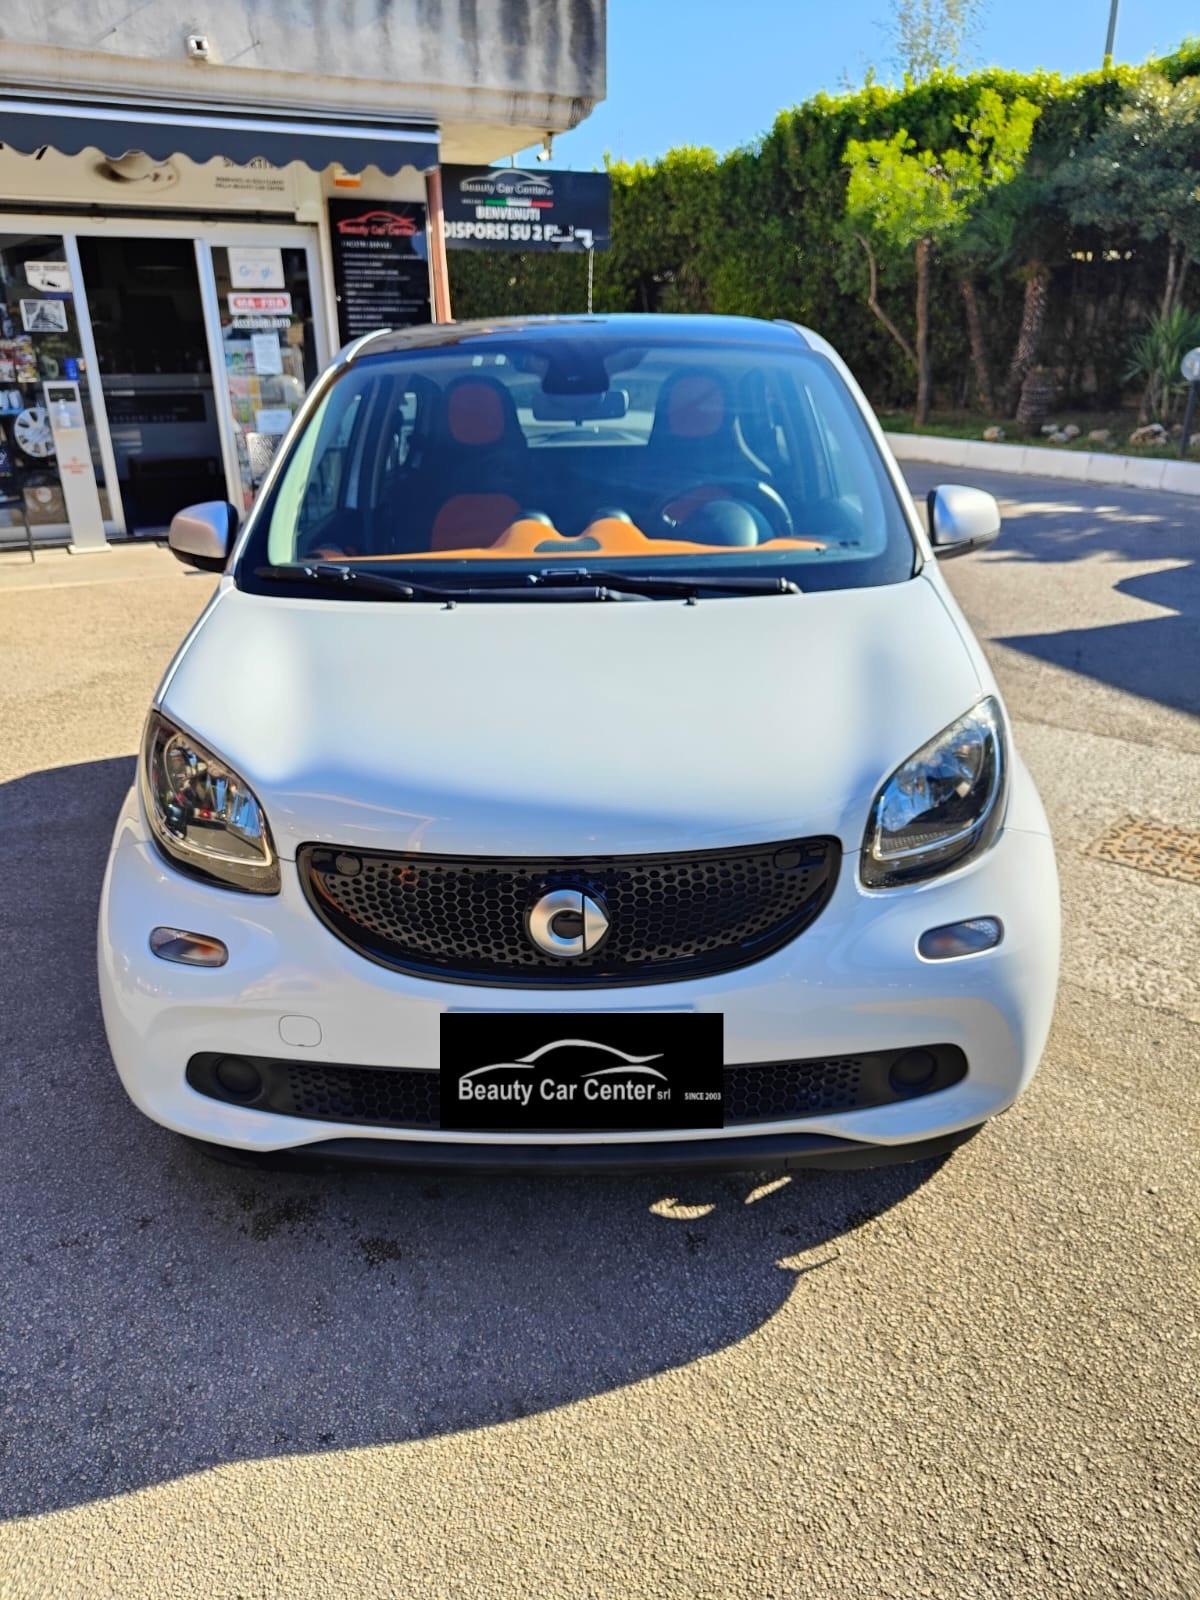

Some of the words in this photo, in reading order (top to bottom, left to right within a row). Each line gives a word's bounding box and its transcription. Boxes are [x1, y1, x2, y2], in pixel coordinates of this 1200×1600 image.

[496, 183, 514, 194] Car
[475, 206, 541, 221] BENVENUTI
[510, 223, 531, 241] SU
[531, 224, 543, 241] 2
